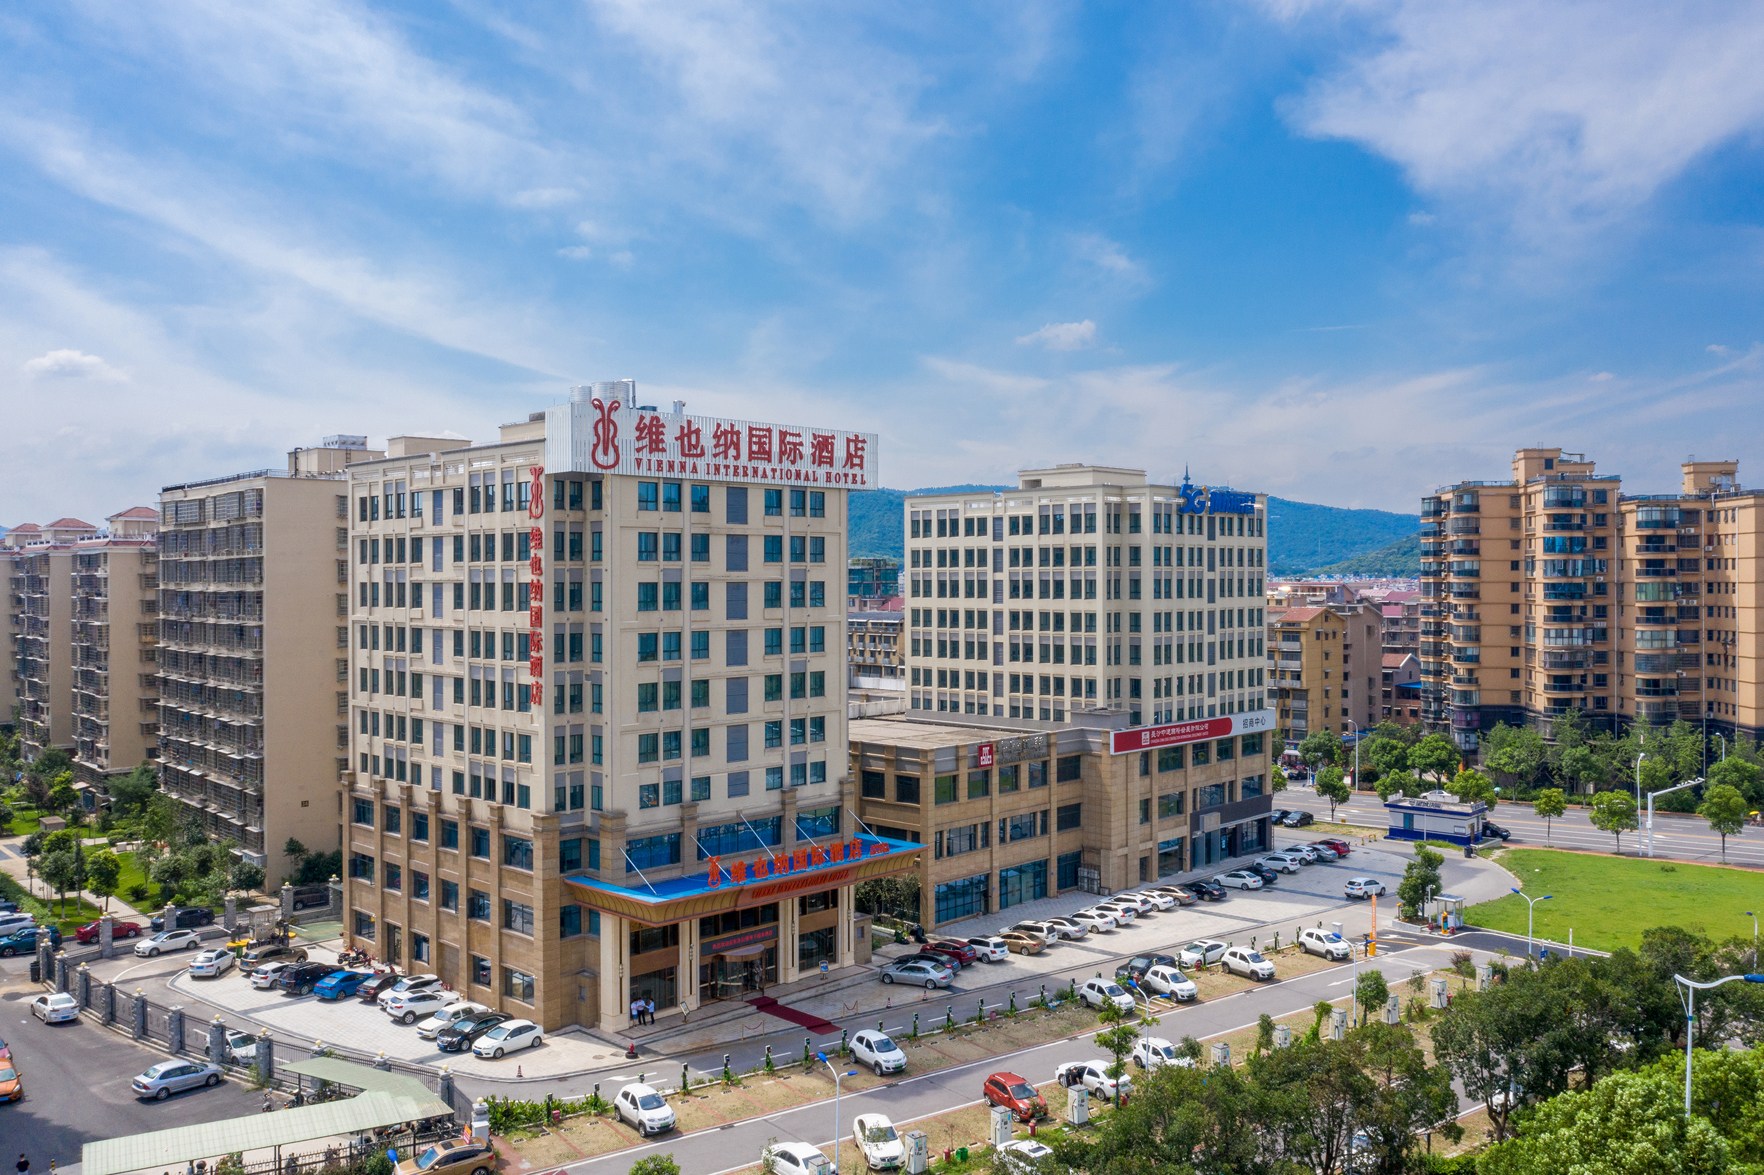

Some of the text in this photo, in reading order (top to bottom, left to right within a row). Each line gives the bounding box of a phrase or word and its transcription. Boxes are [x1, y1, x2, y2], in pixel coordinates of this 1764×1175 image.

[634, 413, 867, 470] 维也纳国际酒店
[635, 457, 866, 485] VIENNA INTERNATIONAL HOTEL
[529, 526, 543, 706] 维也纳国际酒店
[1242, 716, 1267, 729] 招商中心
[730, 838, 863, 884] 维也纳国际酒店
